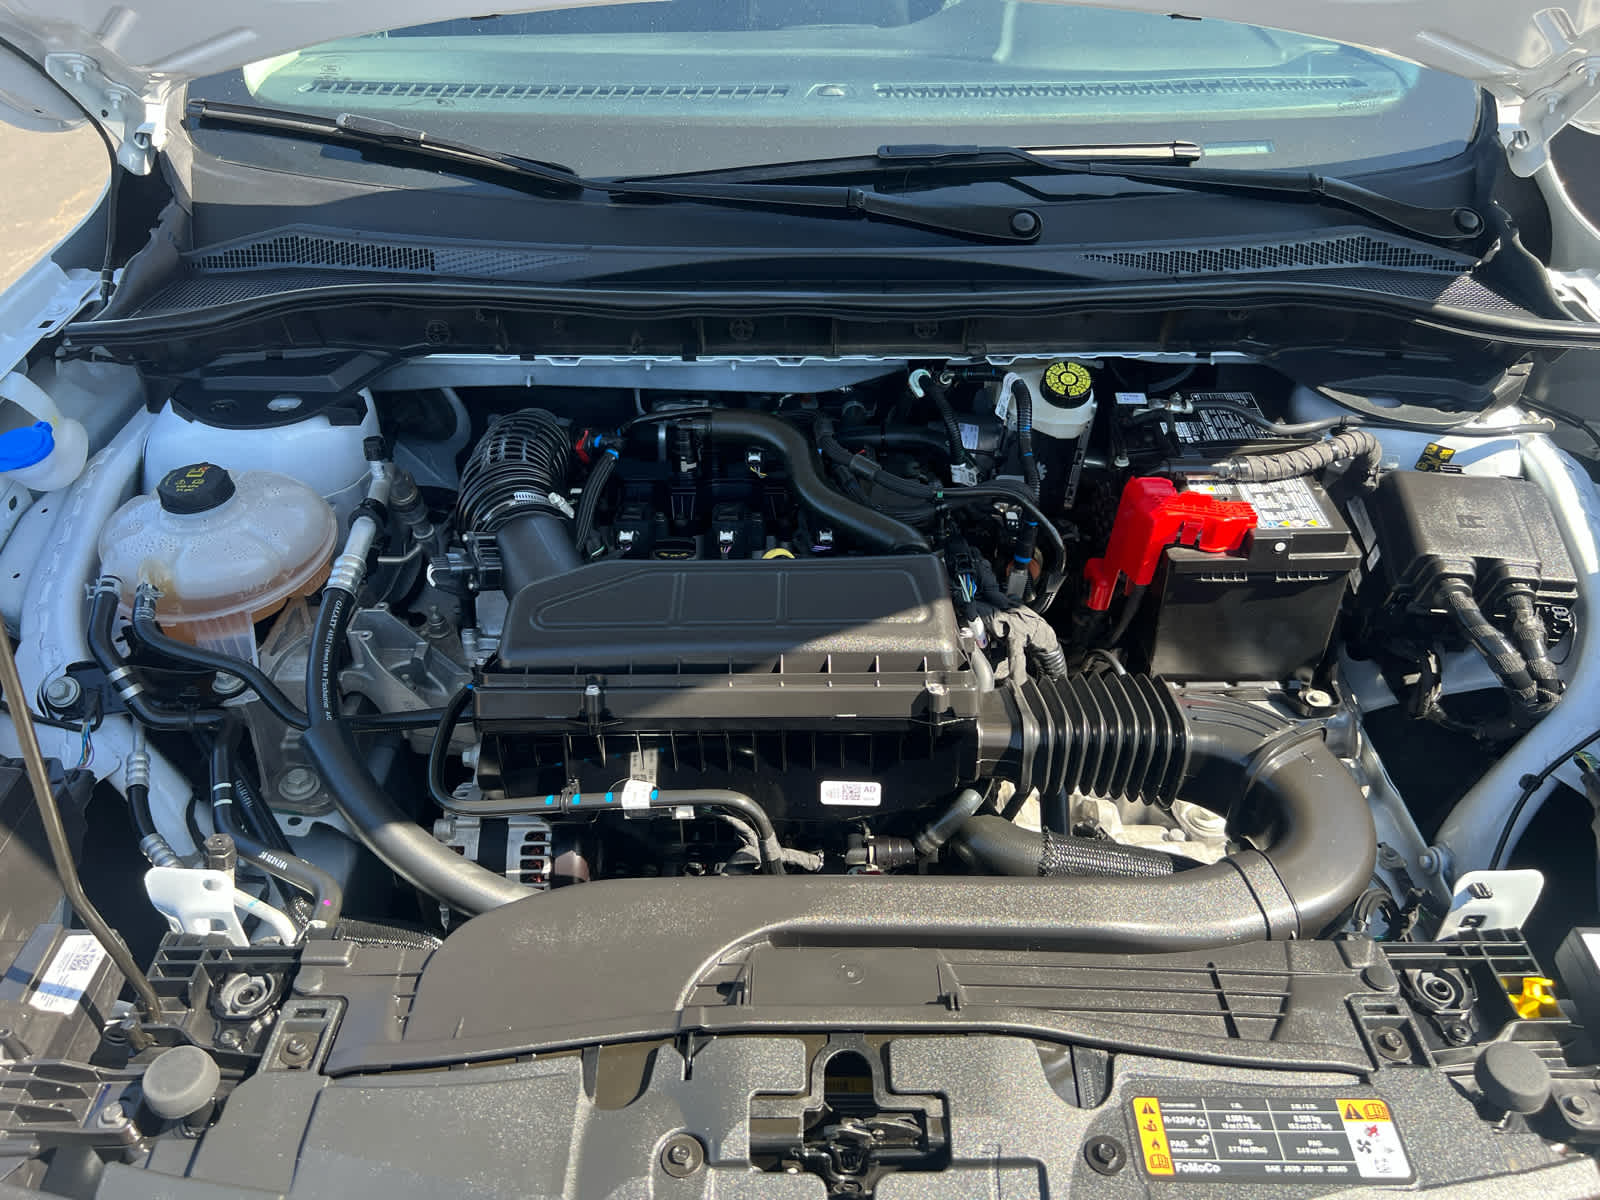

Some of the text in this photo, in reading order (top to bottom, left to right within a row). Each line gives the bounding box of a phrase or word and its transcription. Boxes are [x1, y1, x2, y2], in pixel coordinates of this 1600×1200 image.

[329, 600, 342, 629] GALAXY
[863, 785, 876, 793] AD
[1174, 1162, 1221, 1173] FoMoCo
